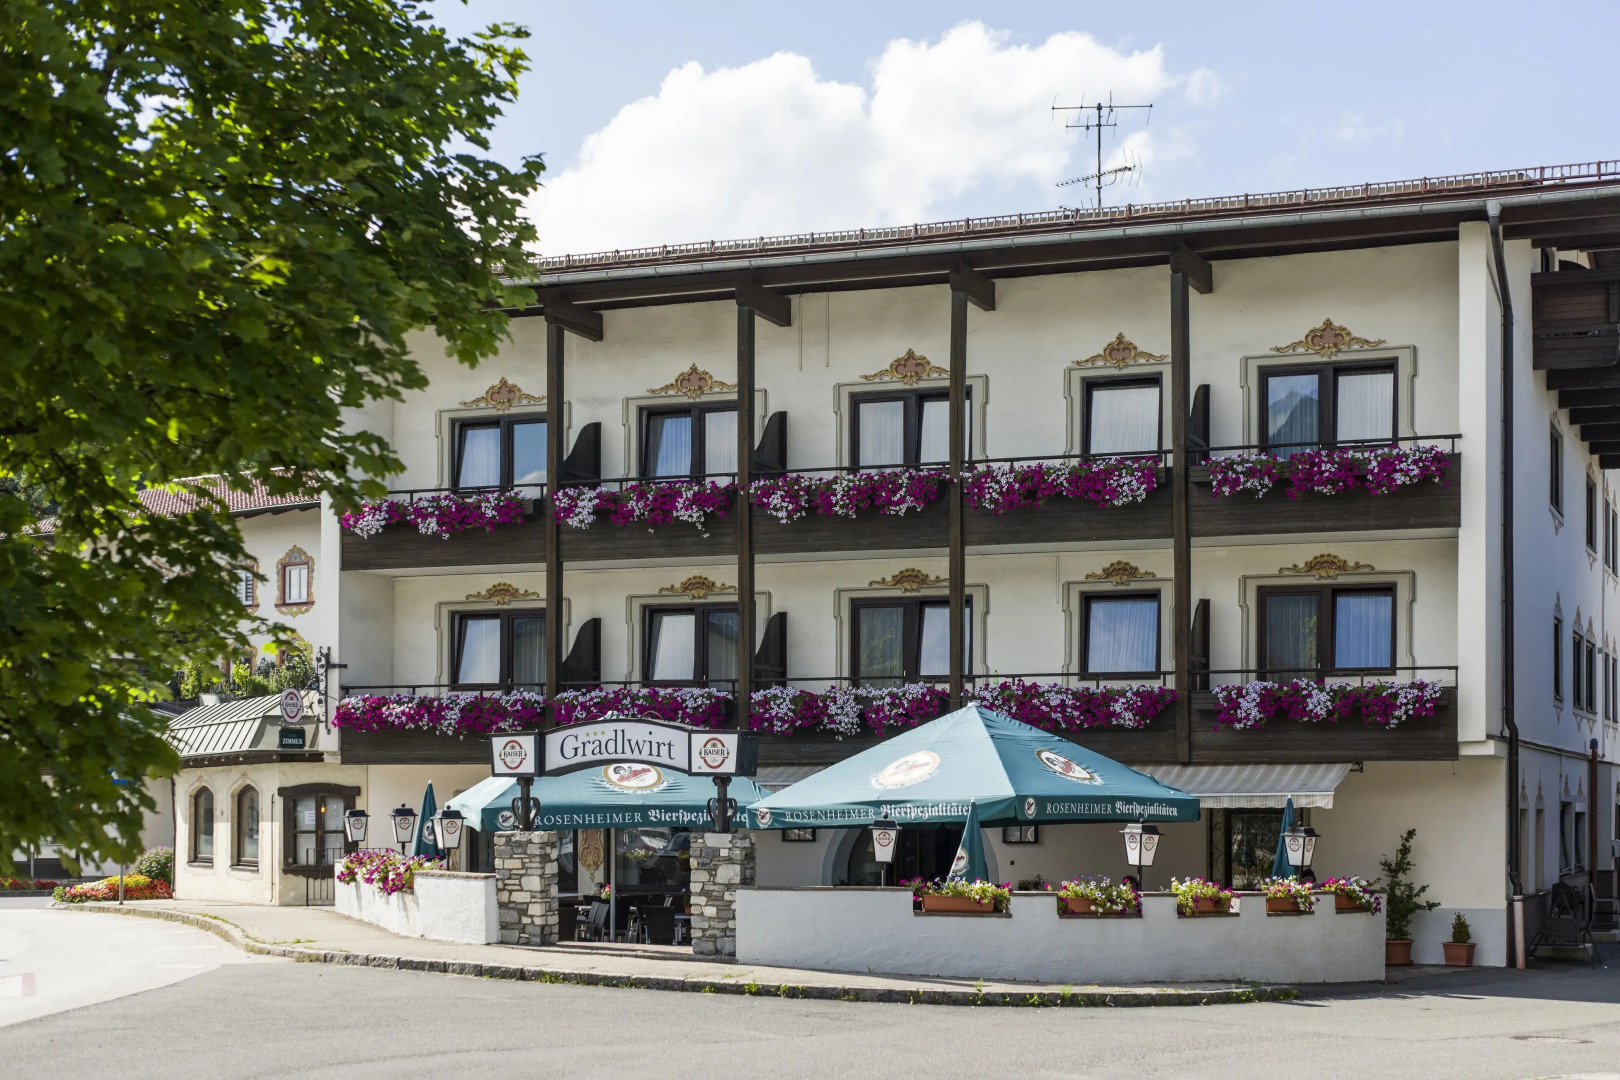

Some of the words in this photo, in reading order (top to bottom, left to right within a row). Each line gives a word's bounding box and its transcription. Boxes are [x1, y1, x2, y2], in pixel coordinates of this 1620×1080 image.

[282, 737, 303, 745] ZIMMER
[560, 729, 675, 760] Gradlwirt
[503, 750, 523, 758] KAISER
[703, 748, 725, 757] KAISER
[785, 808, 876, 822] ROSENHEIMER
[1046, 802, 1112, 815] ROSENHEIMER
[534, 812, 643, 826] ROSENHEIMER
